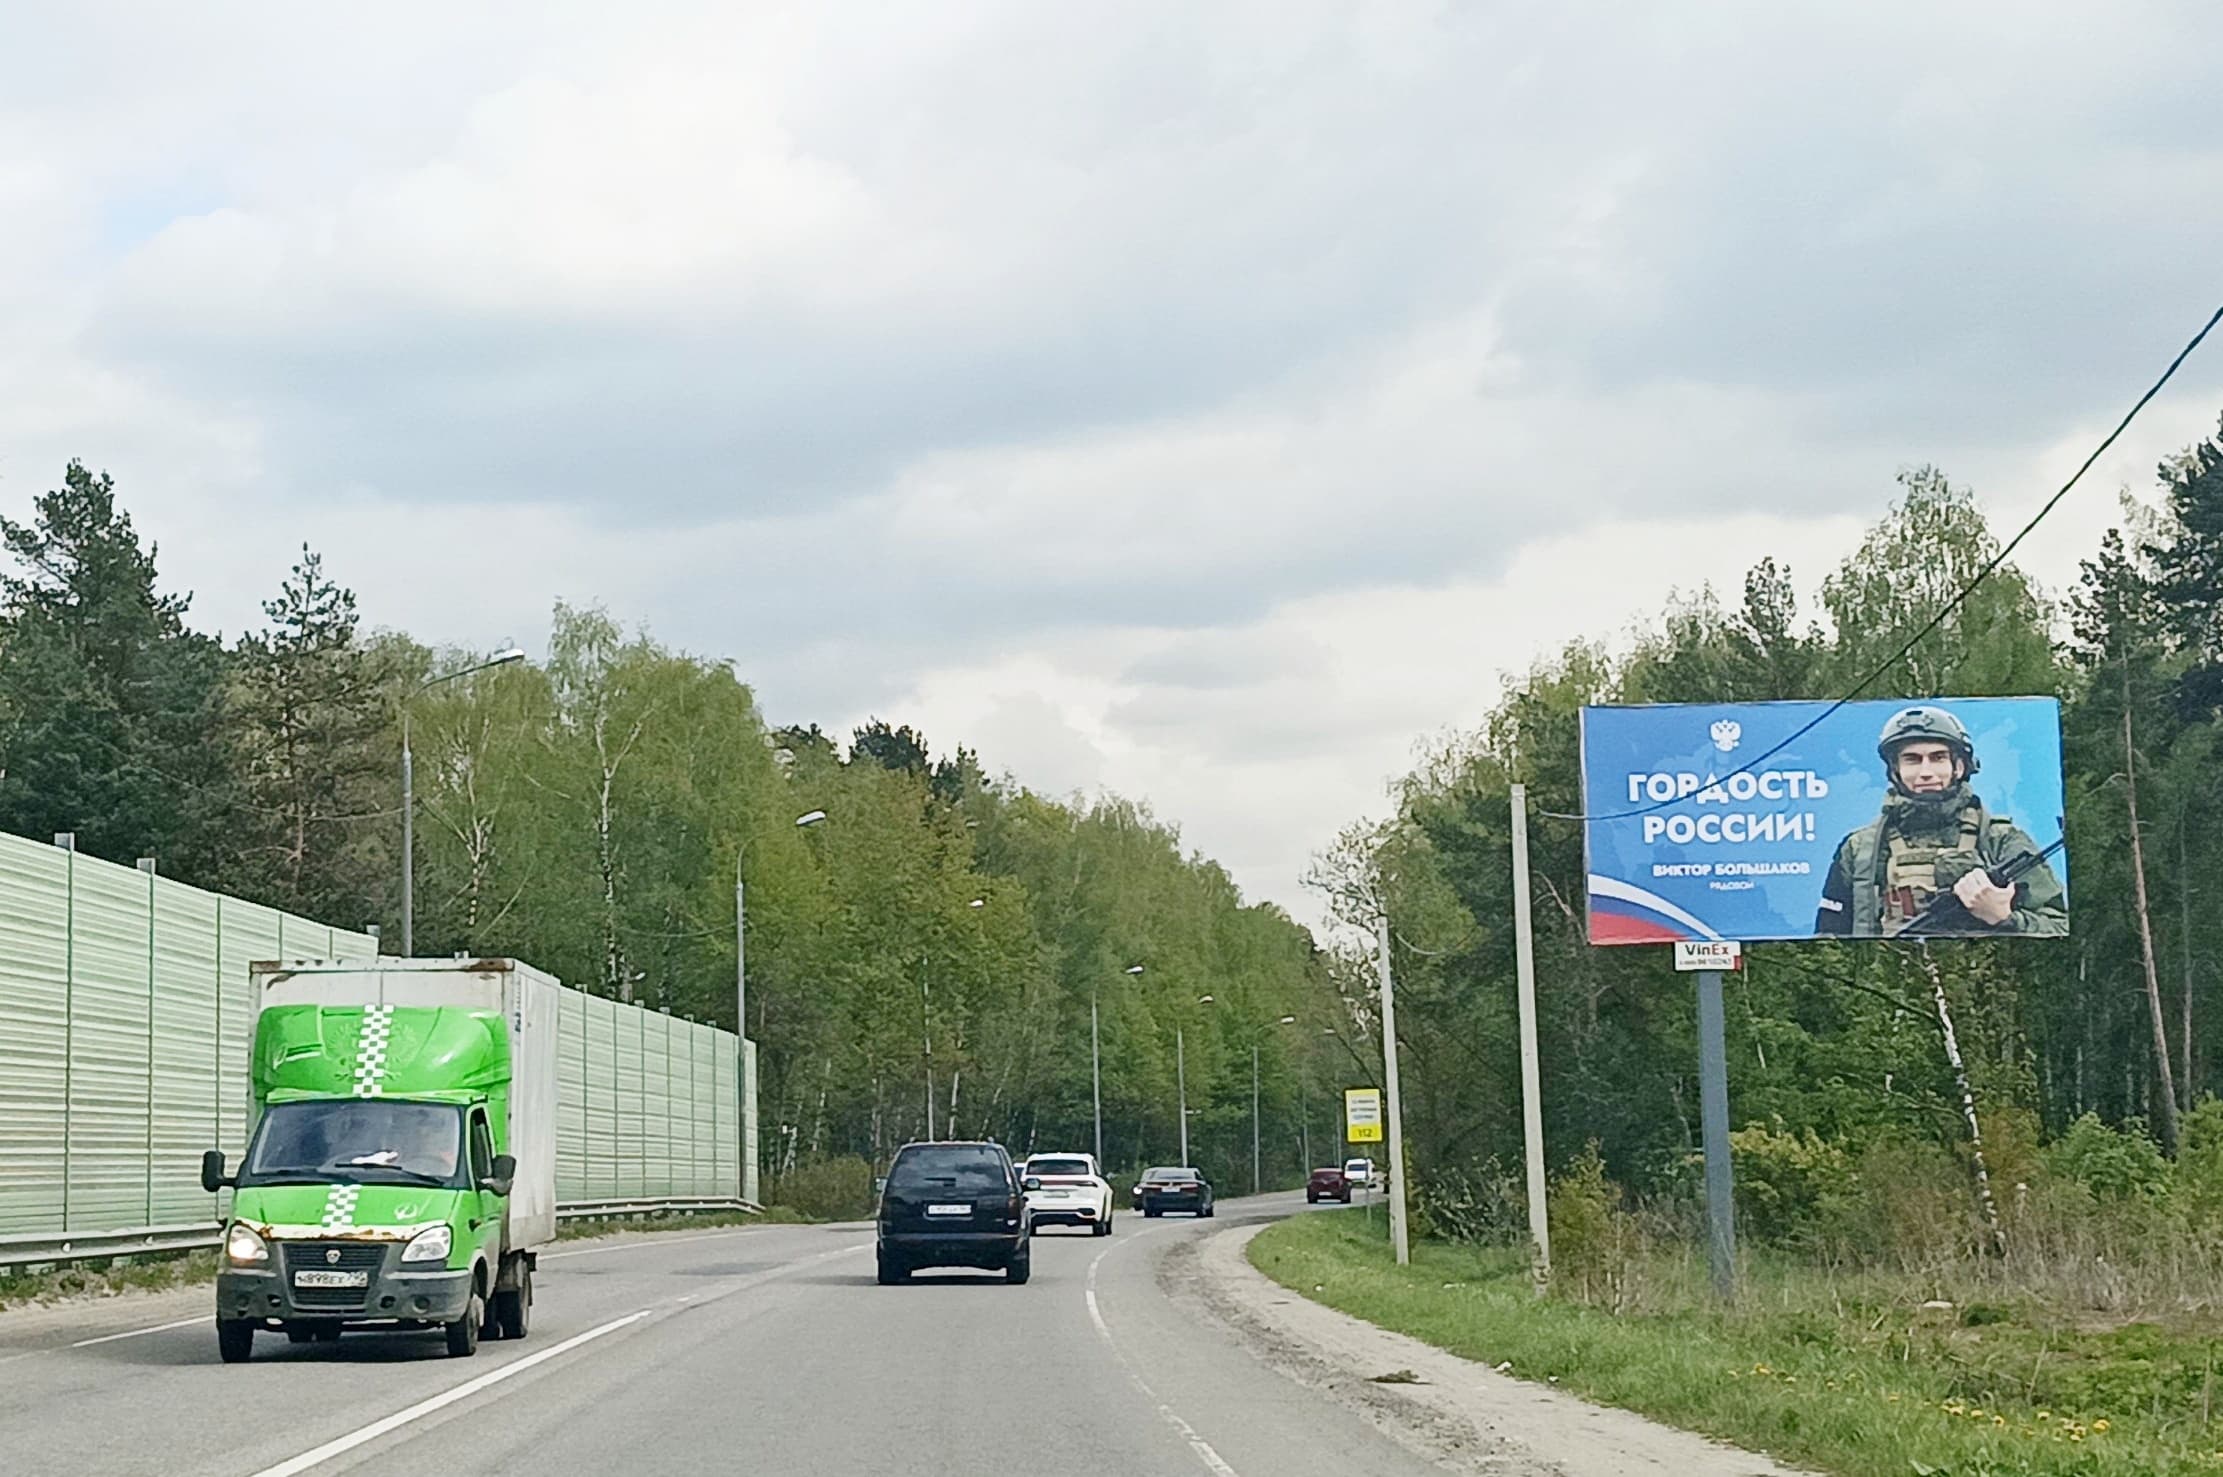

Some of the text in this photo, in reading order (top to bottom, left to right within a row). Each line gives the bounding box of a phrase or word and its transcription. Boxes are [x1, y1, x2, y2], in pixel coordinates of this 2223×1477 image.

[1628, 770, 1829, 804] ГОРДОСТЬ
[1643, 813, 1816, 844] РОССИИ!
[1653, 862, 1811, 877] ВИКТОР БОЛЬШАКОВ
[1685, 944, 1729, 956] VinEx
